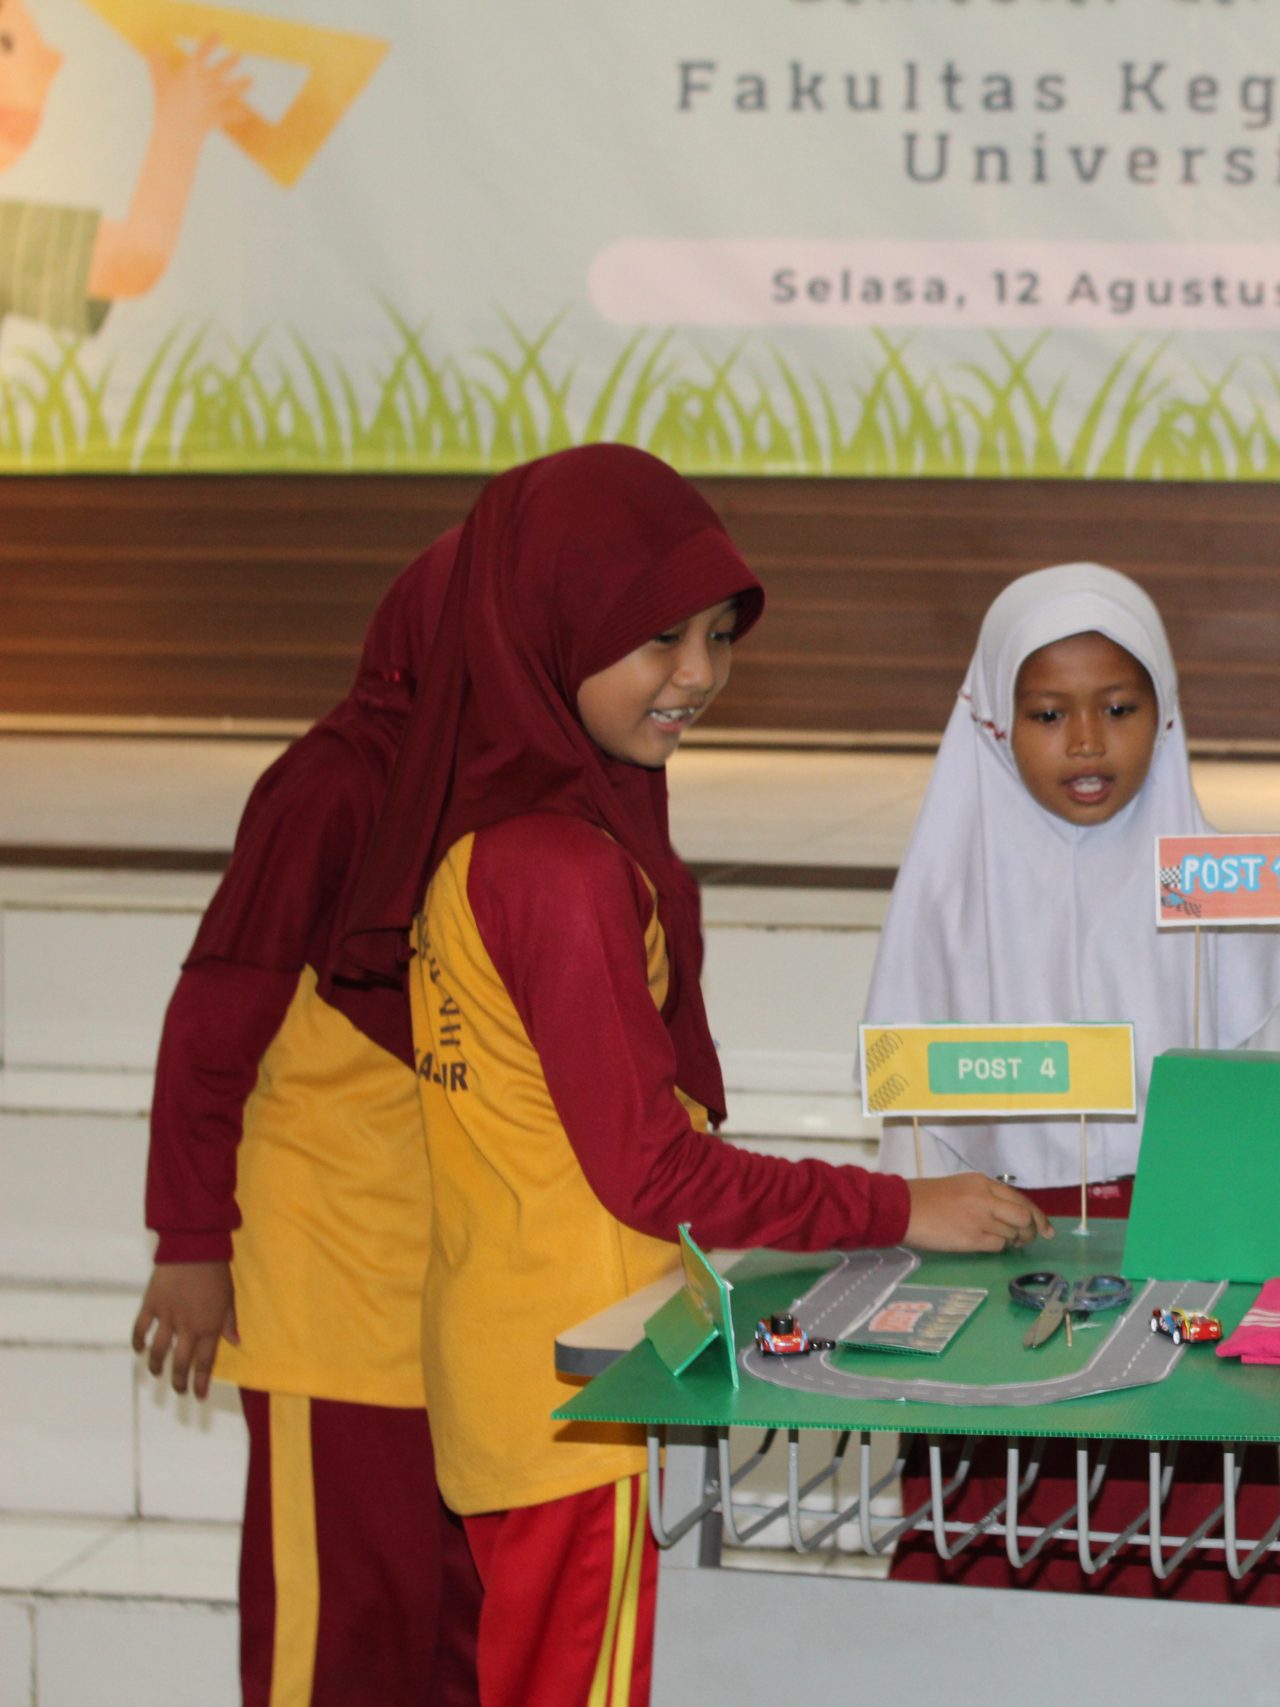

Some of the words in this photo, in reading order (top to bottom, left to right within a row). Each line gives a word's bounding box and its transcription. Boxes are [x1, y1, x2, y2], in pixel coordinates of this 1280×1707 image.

[675, 60, 1067, 113] Fakultas
[771, 268, 969, 310] Selasa,
[992, 271, 1043, 306] 12
[1183, 855, 1263, 890] POST
[959, 1058, 1022, 1079] POST
[1039, 1057, 1057, 1079] 4
